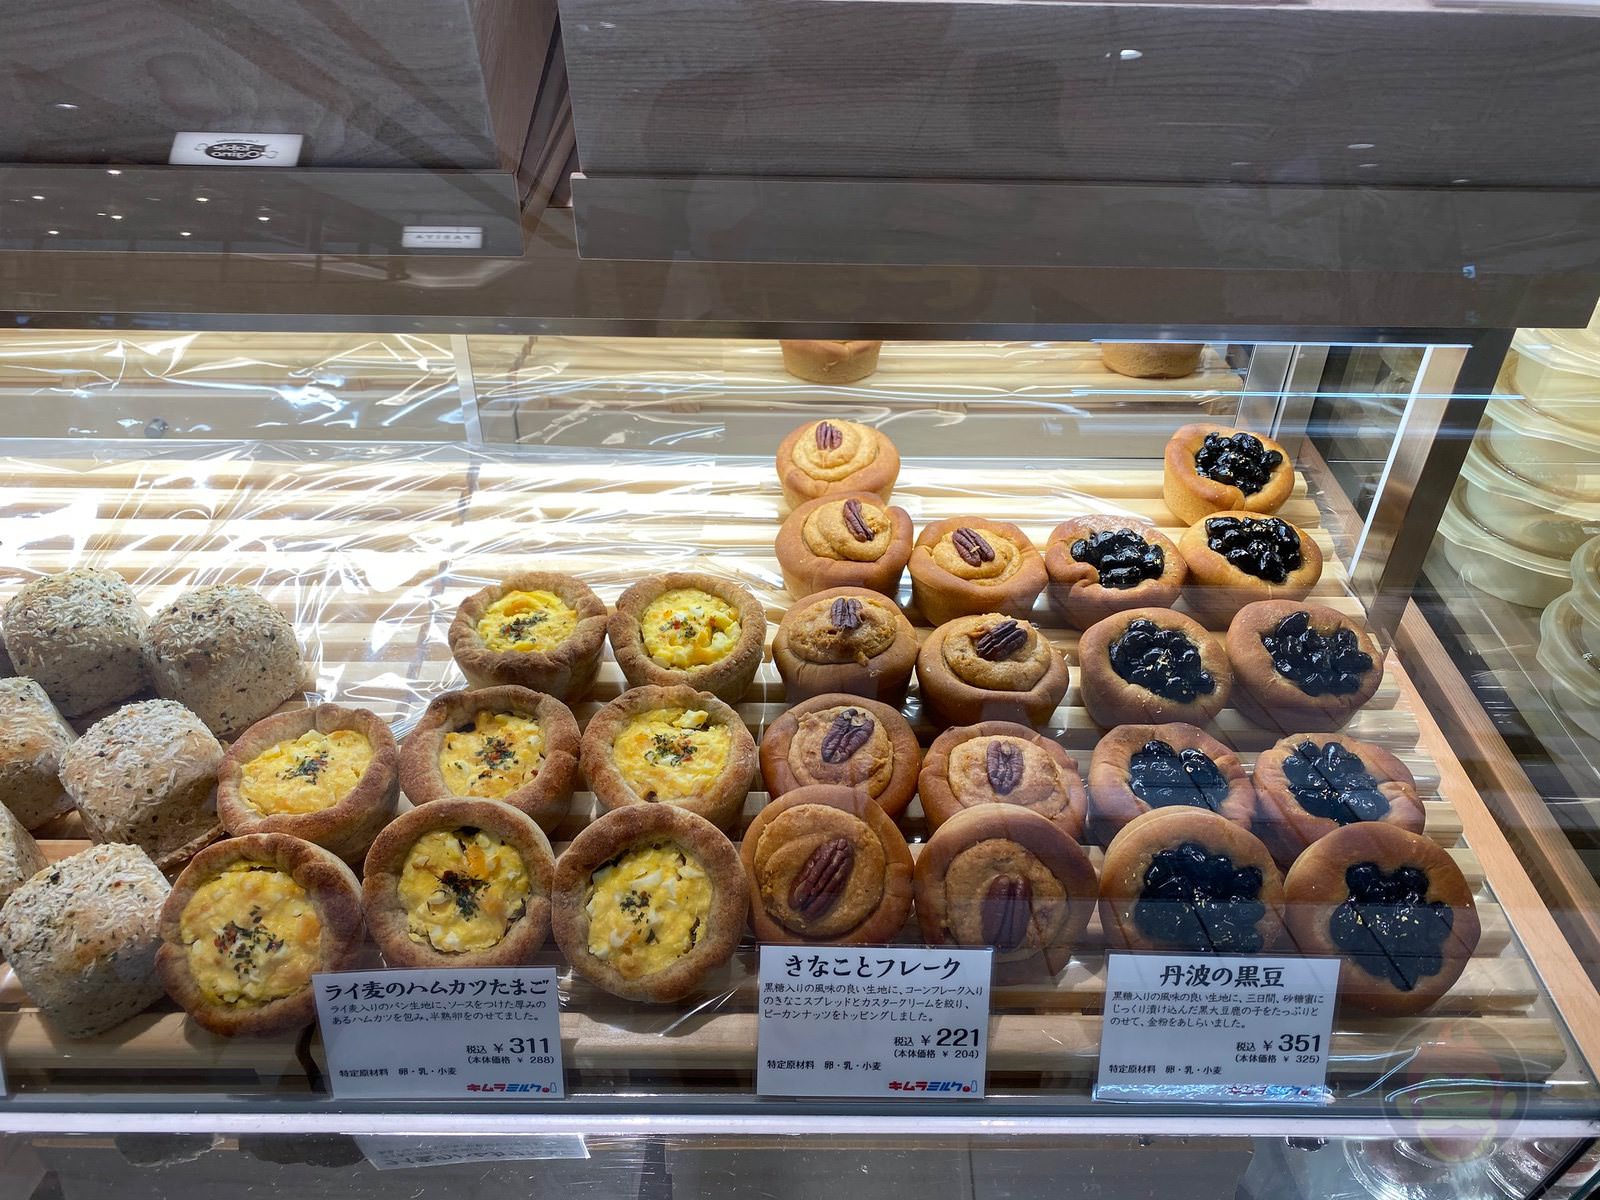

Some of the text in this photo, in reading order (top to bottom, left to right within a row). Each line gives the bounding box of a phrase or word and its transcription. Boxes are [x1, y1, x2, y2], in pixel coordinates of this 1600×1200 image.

[784, 954, 961, 980] きなことフレーク
[1159, 963, 1285, 988] 丹波の黒豆
[324, 978, 550, 1002] ライ麦のハムカツたまご
[763, 982, 983, 996] 黒糖入りの風味の良い生地に、コーンフレーク入り
[1111, 991, 1325, 1005] 黒糖入りの風味の良い生地に、三日間、砂糖蜜に
[330, 1000, 547, 1014] ライ麦入りのパン生地に、ソースをつけた厚みの
[1112, 1004, 1319, 1017] じっくり漬け込んだ黒大豆鹿の子をたっぷりと
[1110, 1017, 1247, 1029] のせて、金粉をあしらいました。
[894, 1028, 979, 1047] 税込 ¥ 221
[1236, 1033, 1321, 1052] 税込 ¥ 351
[466, 1037, 550, 1054] 税込 ¥ 311
[467, 1055, 511, 1065] (本体価格
[530, 1055, 555, 1064] 288)
[894, 1049, 936, 1059] (本体価格
[954, 1049, 979, 1059] 204)
[1235, 1054, 1277, 1064] (本体価格
[1296, 1054, 1320, 1064] 325)
[767, 1060, 815, 1070] 特定原材料
[1109, 1064, 1156, 1074] 特定原材料
[339, 1067, 389, 1077] 特定原材料
[466, 1082, 542, 1093] キムラミルク
[888, 1080, 963, 1092] キムラミルク
